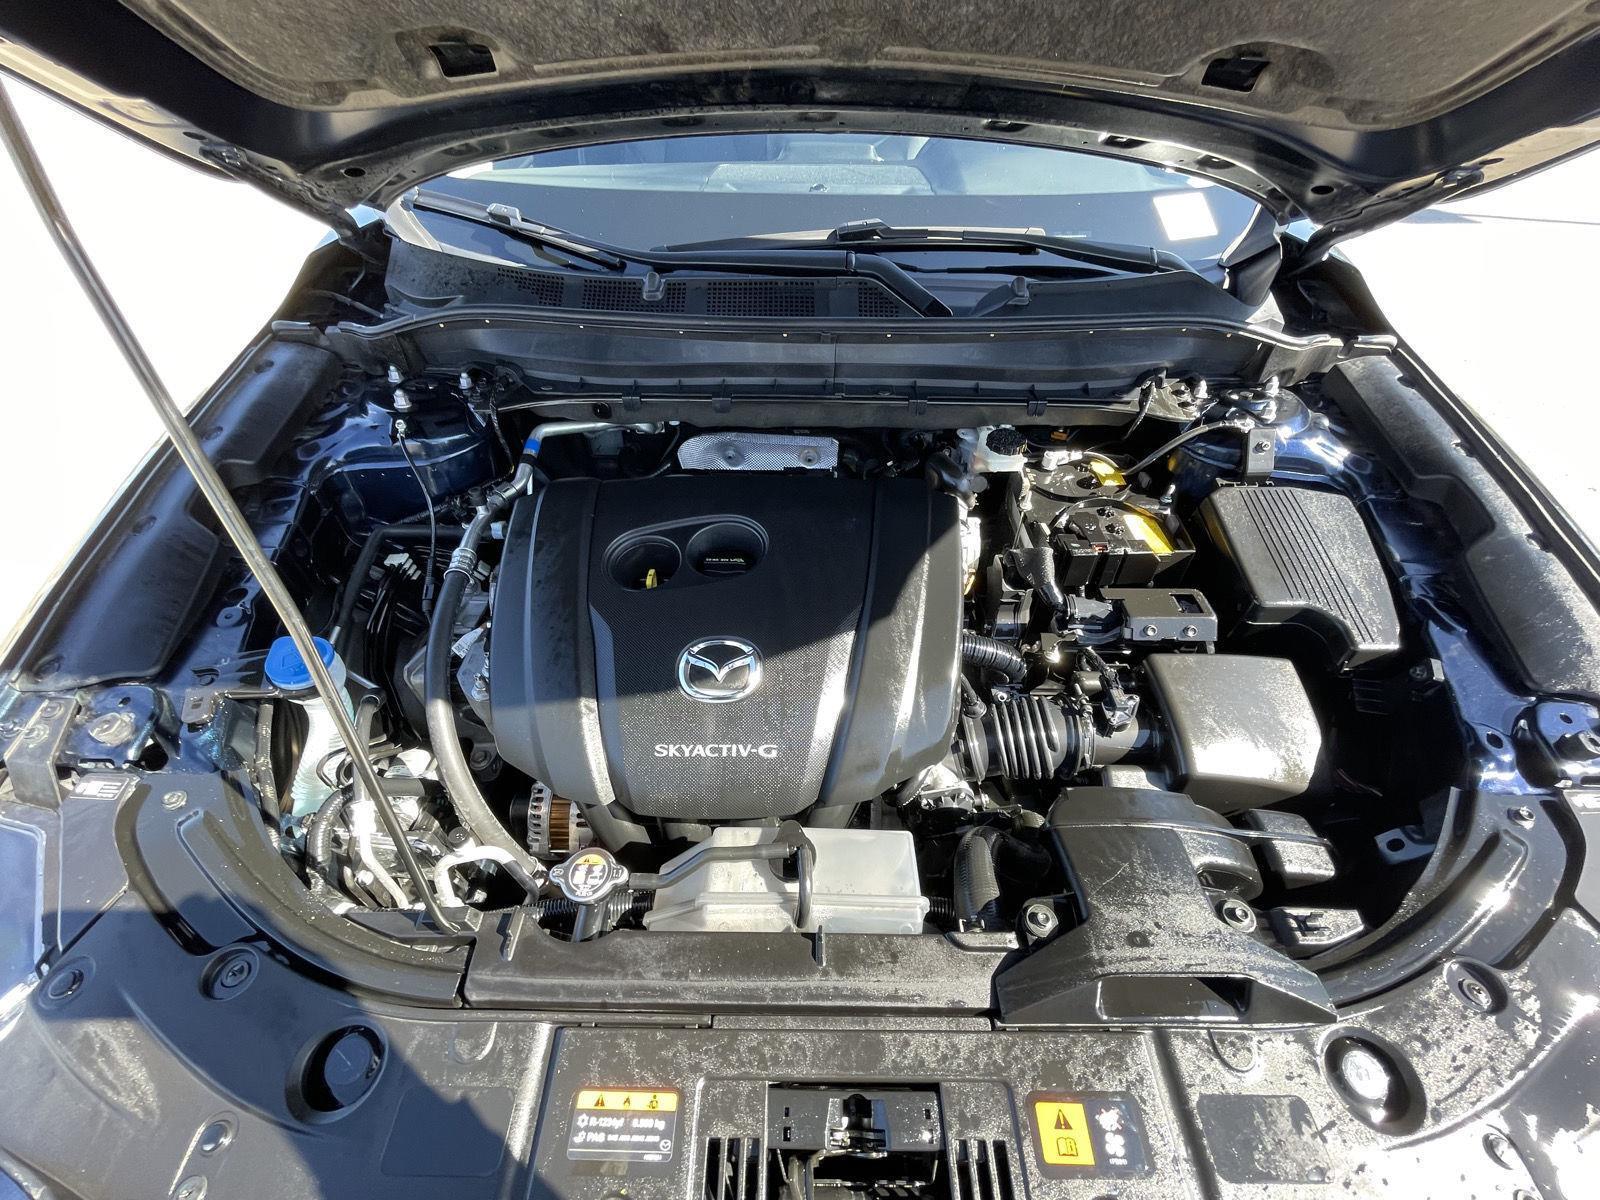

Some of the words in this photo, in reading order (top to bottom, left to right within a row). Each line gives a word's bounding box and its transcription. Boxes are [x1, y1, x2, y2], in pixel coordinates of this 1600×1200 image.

[654, 743, 779, 758] SKYACTIV-G
[654, 1118, 665, 1131] kg
[586, 1132, 605, 1142] PAG
